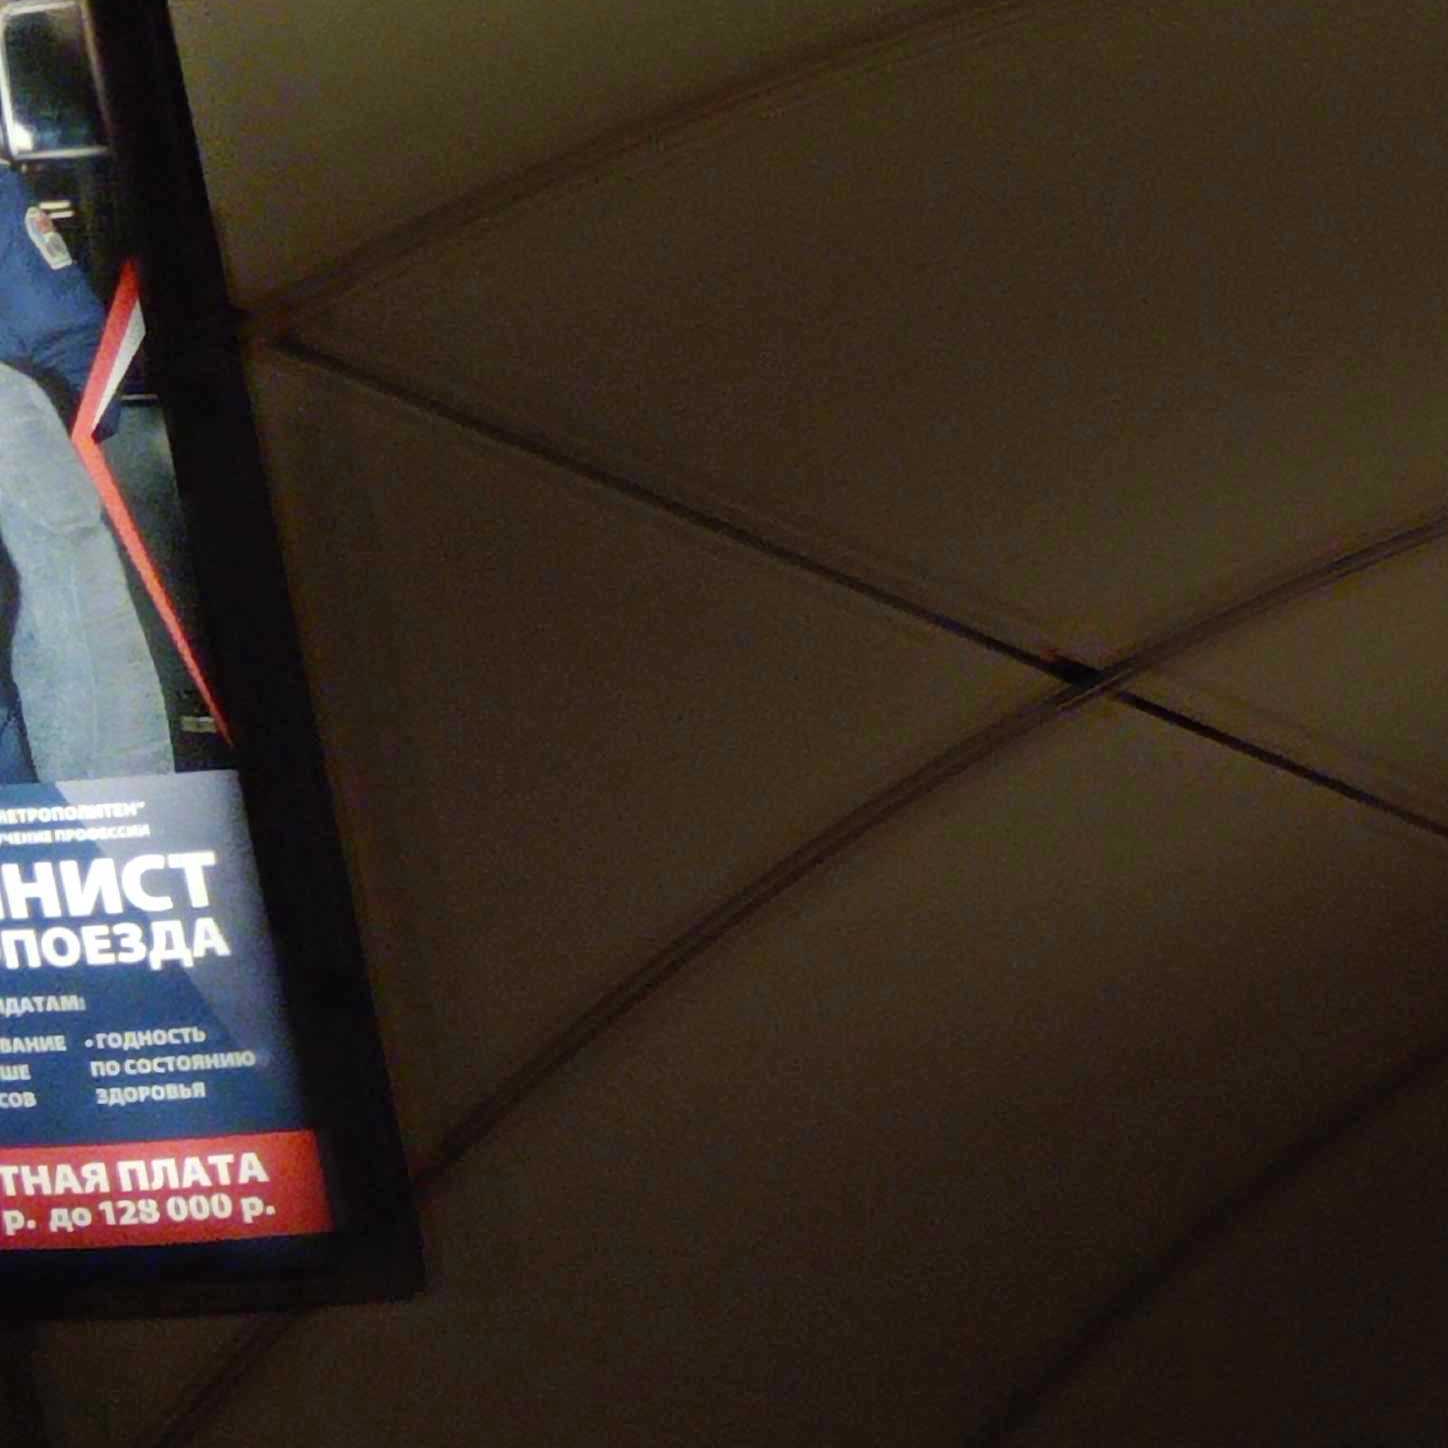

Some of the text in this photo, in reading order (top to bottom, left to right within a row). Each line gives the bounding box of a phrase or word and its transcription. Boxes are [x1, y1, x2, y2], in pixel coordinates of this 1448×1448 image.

[0, 851, 216, 919] НИСТ
[0, 917, 231, 970] ПОЕЗДА
[95, 1026, 207, 1050] ГОДНОСТЬ
[90, 1050, 256, 1077] ПО СОСТОЯНИЮ
[95, 1081, 207, 1107] ЗДОРОВЬЯ
[0, 1152, 270, 1197] ТНАЯ ПЛАТА
[50, 1206, 92, 1232] до
[98, 1198, 160, 1226] 128
[167, 1192, 233, 1220] 000
[240, 1195, 277, 1224] р.
